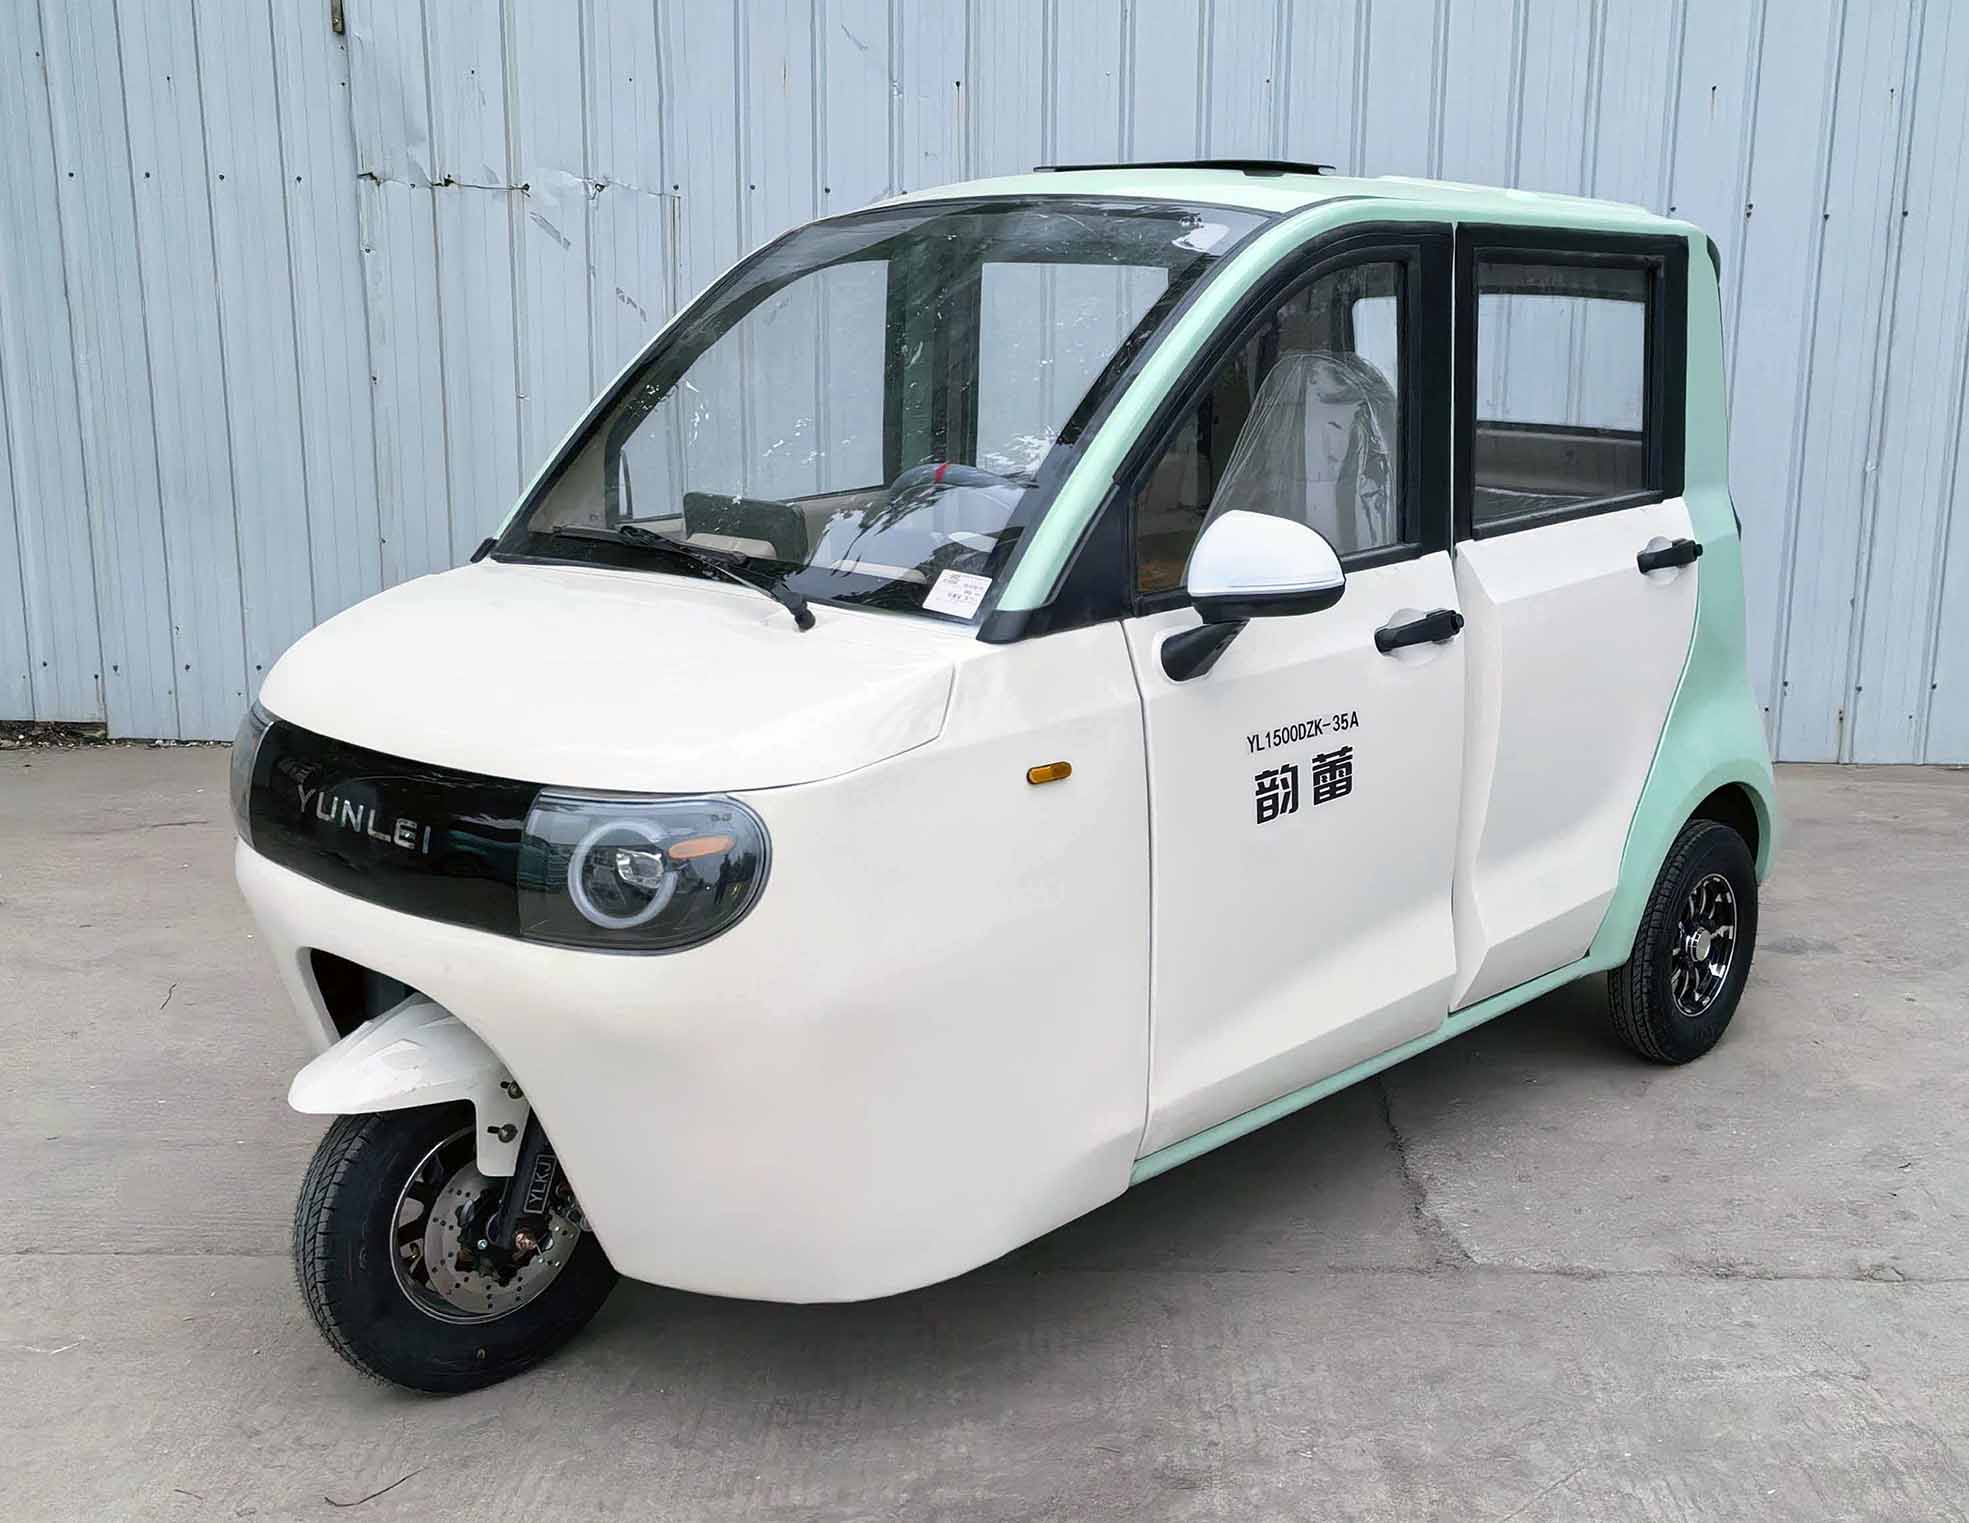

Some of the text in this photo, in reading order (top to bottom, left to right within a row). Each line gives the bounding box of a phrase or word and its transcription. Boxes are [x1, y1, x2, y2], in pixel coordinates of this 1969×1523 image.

[1247, 711, 1359, 752] YL1500DZK-35A
[297, 784, 432, 854] YUNLEI
[529, 1162, 551, 1203] YLKJ
